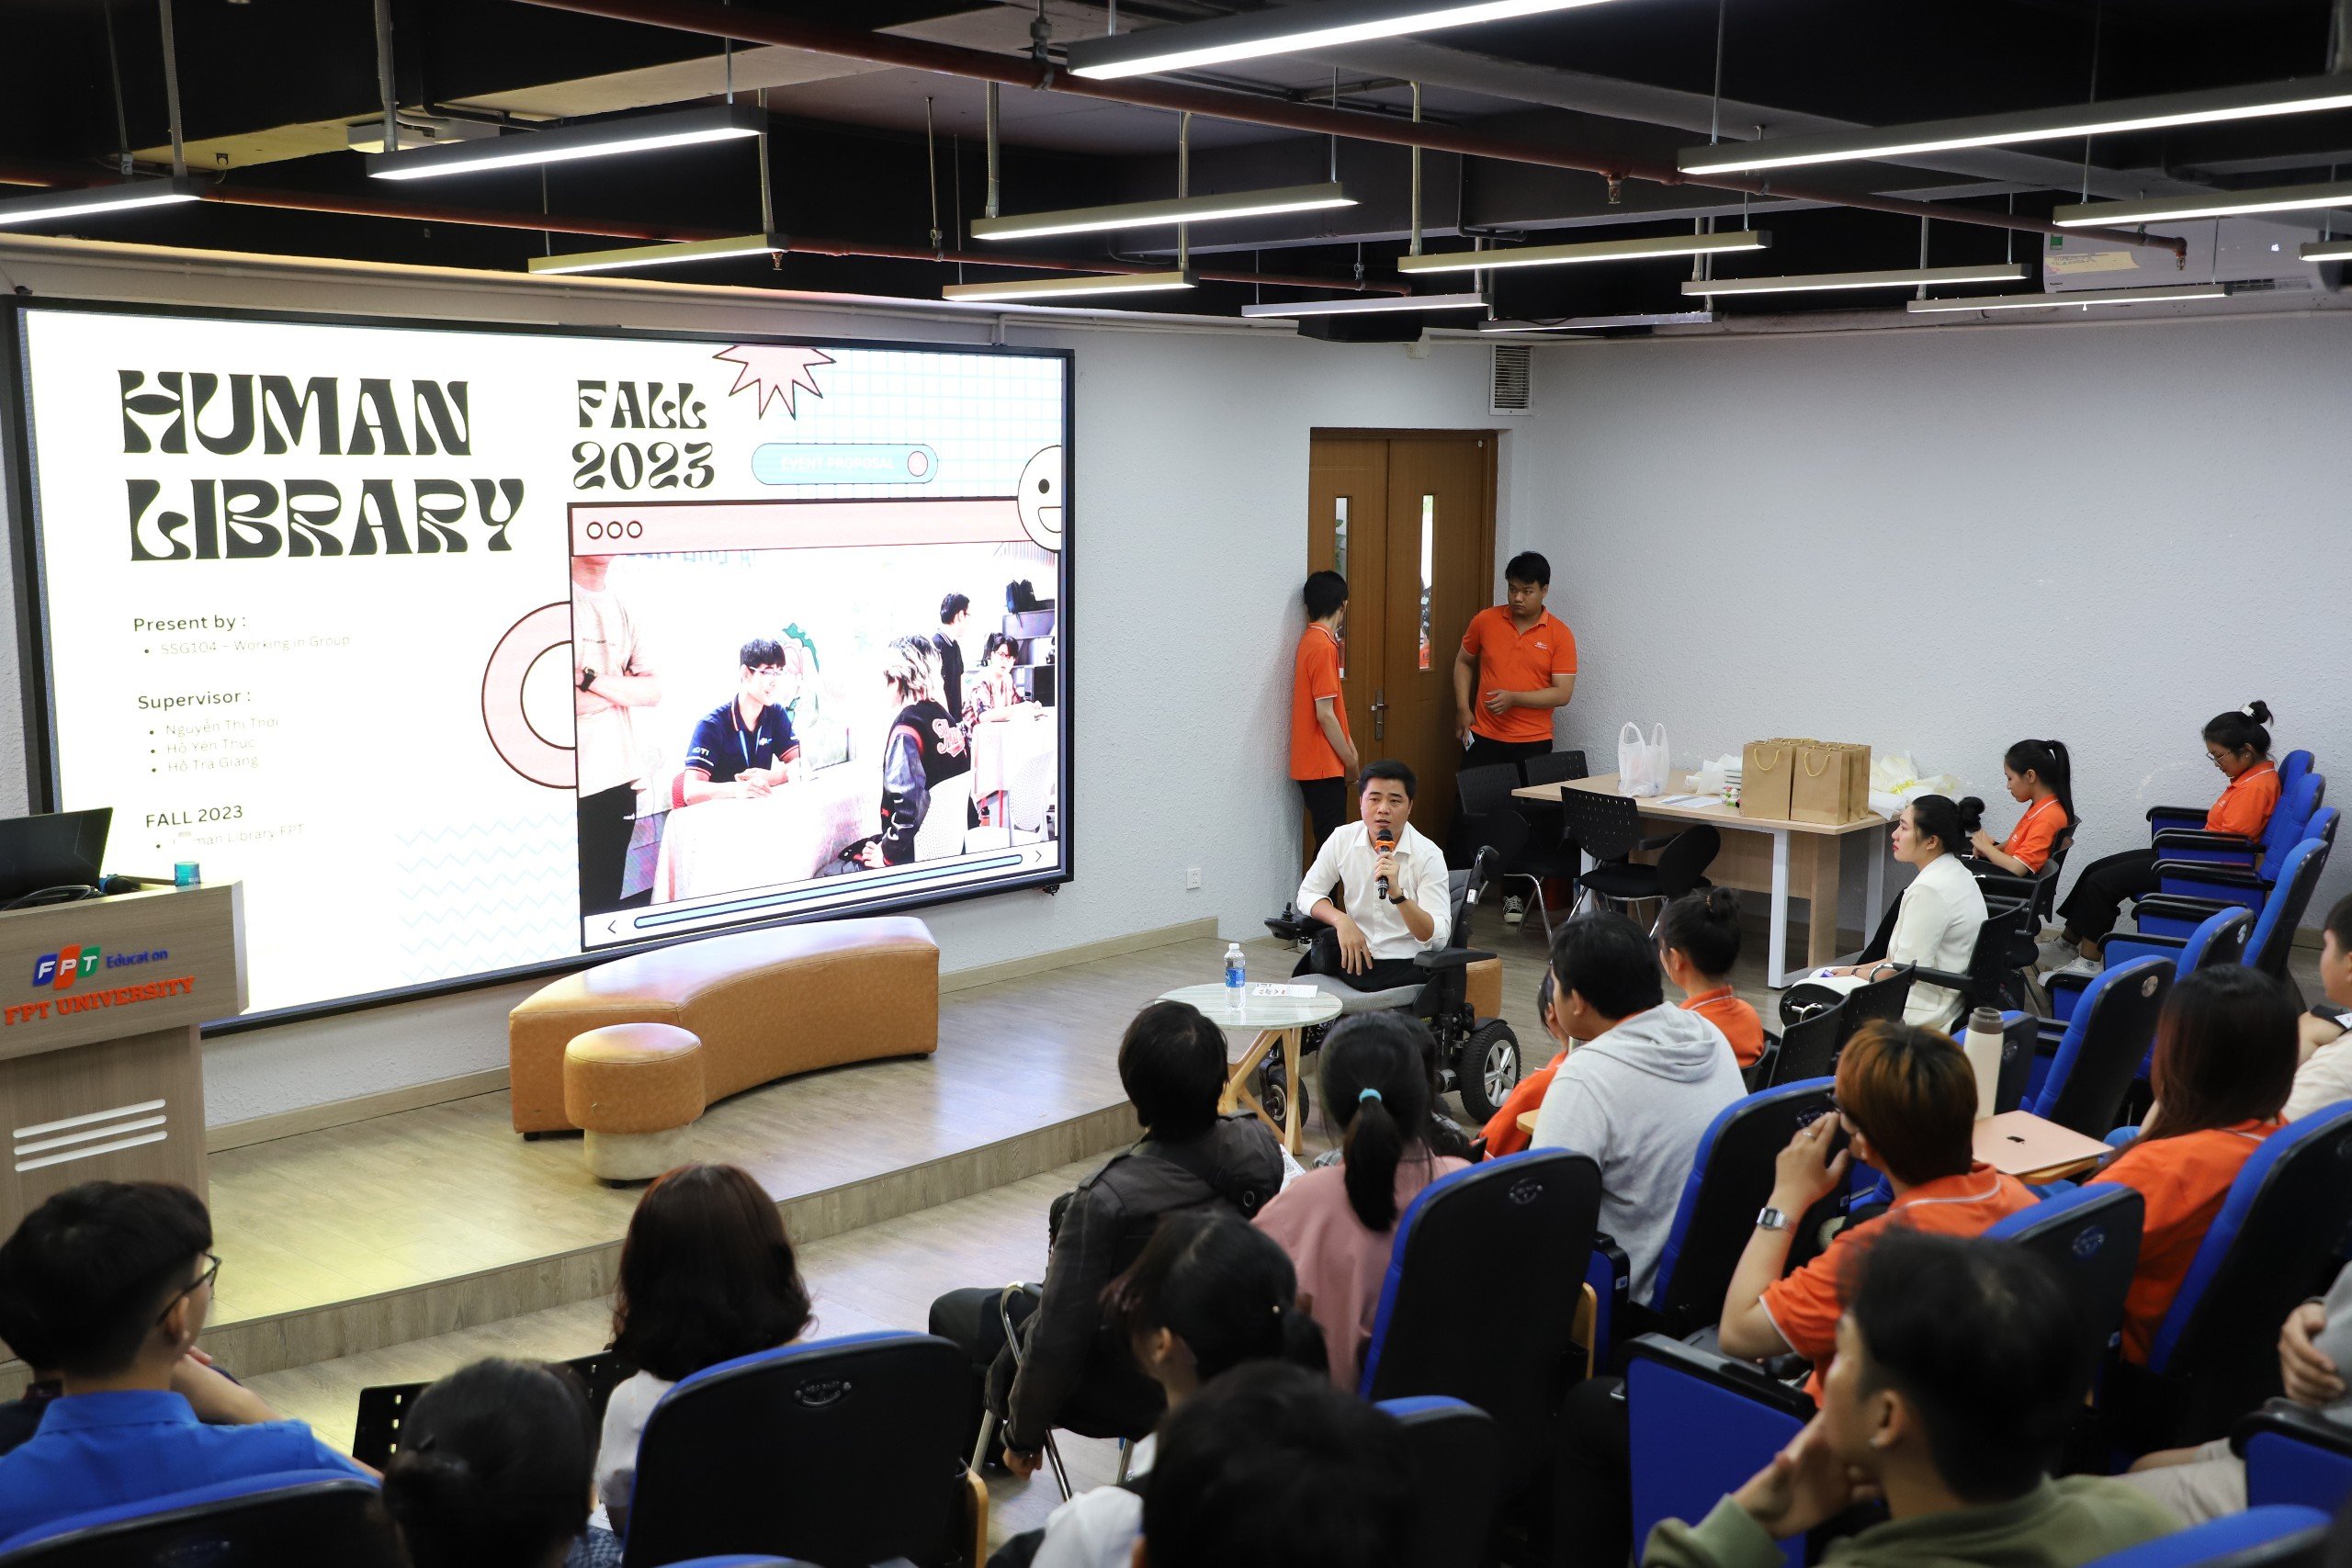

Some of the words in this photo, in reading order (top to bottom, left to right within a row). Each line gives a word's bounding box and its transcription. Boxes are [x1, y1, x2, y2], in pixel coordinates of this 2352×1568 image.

[118, 370, 471, 456] HUMAN
[577, 380, 707, 430] FALL
[571, 441, 715, 491] 2023
[780, 456, 823, 471] EVENT
[826, 456, 896, 470] PROPOSAL
[126, 479, 525, 561] LIBRARY
[133, 617, 208, 632] Present
[214, 615, 236, 632] by
[161, 641, 217, 655] SSG104
[233, 639, 289, 652] Working
[293, 637, 305, 648] in
[310, 637, 351, 649] Group
[138, 691, 241, 712] Supervisor
[146, 811, 192, 829] FALL
[198, 805, 243, 822] 2023
[228, 829, 276, 843] Library
[37, 953, 98, 981] FPT
[5, 1001, 51, 1025] FPT
[56, 976, 195, 1016] UNIVERSITY
